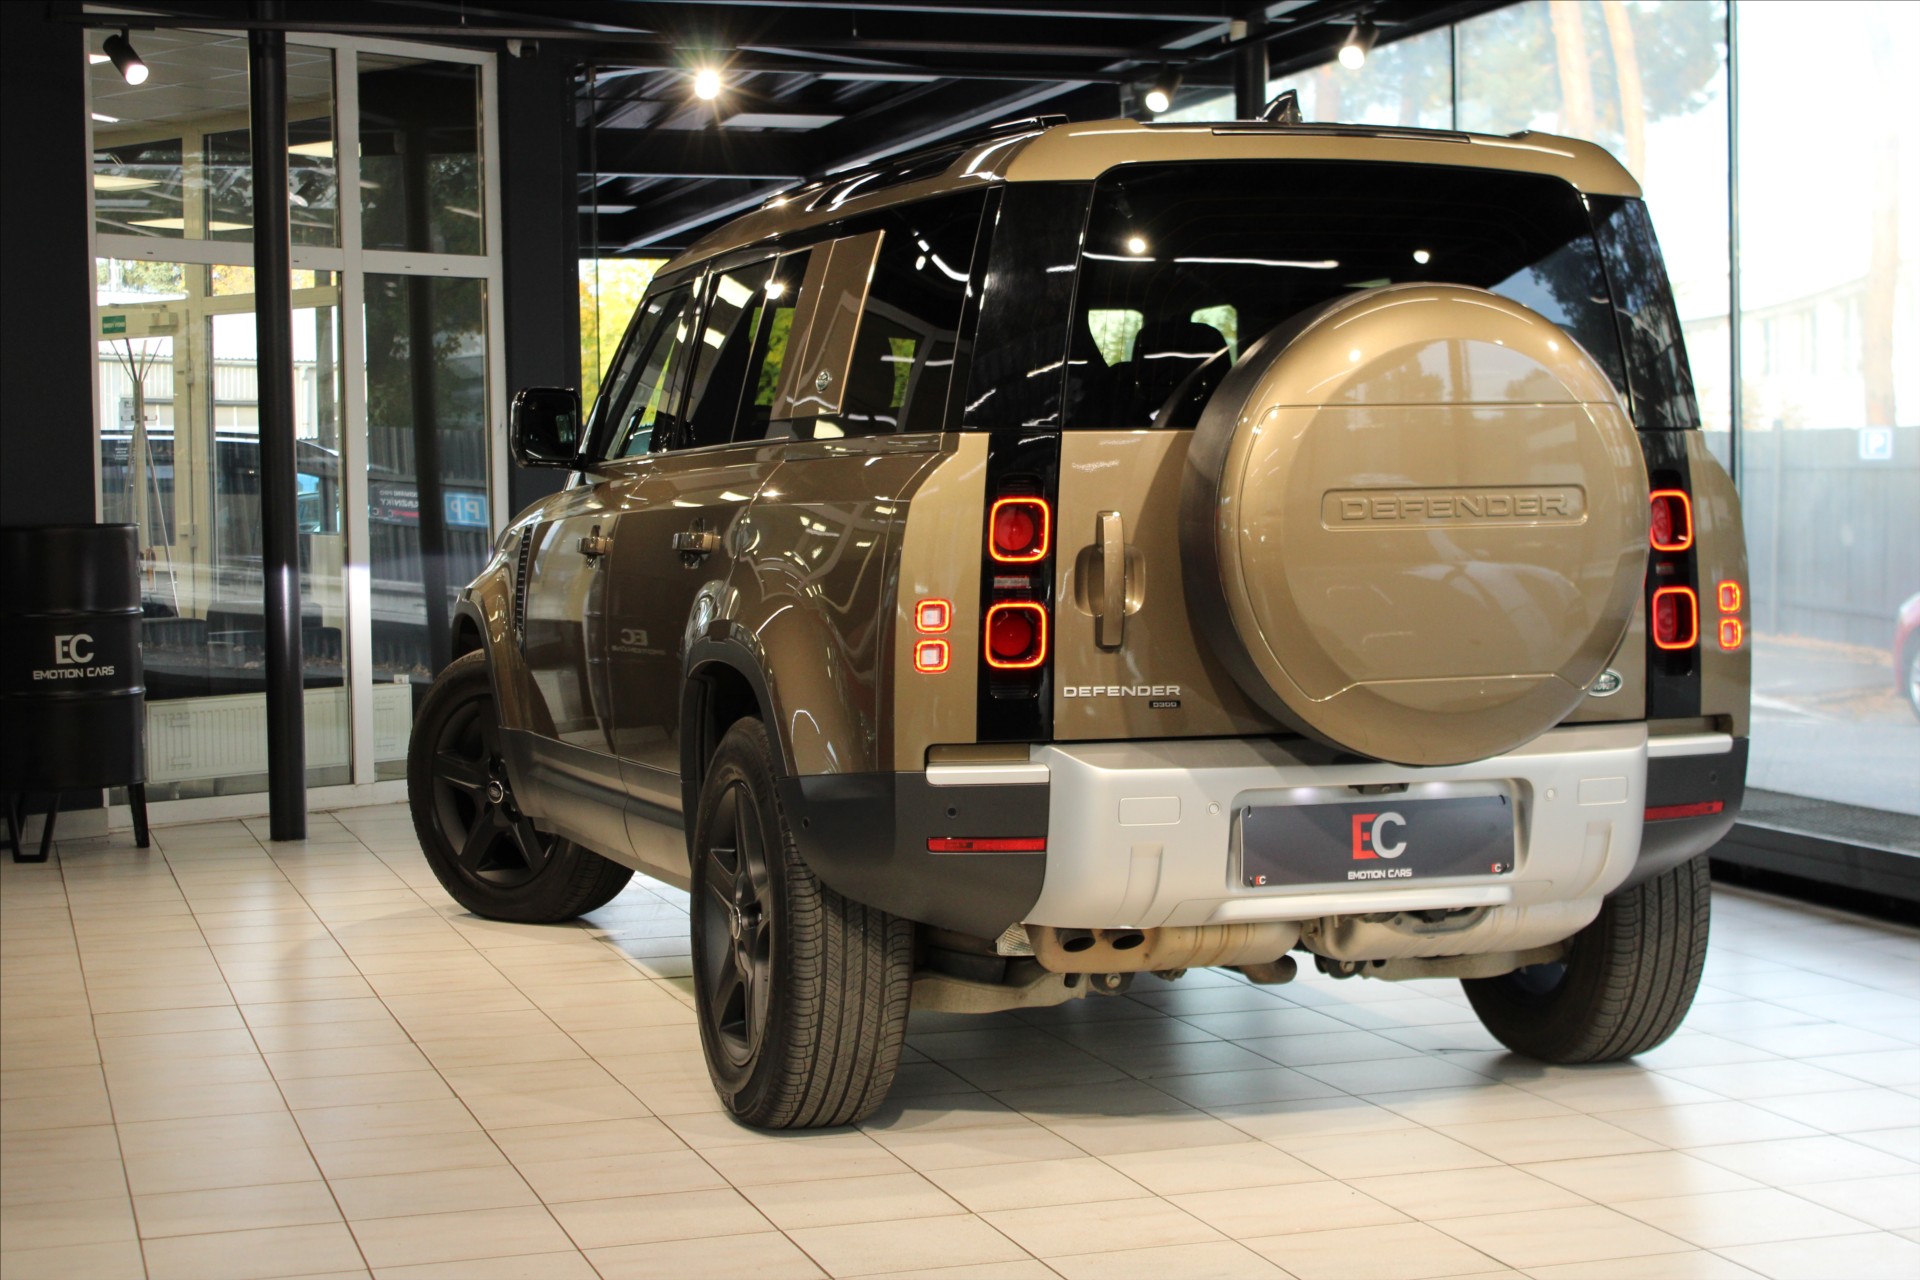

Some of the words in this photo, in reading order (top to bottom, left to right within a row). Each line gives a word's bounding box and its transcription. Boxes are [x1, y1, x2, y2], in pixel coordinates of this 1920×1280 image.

[1869, 432, 1885, 455] P
[1340, 493, 1570, 520] DEFENDER
[55, 633, 94, 664] EC
[33, 669, 83, 680] EMOTION
[86, 665, 115, 677] CARS
[1063, 685, 1181, 698] DEFENDER
[1352, 811, 1407, 860] EC
[1347, 869, 1386, 880] EMOTION
[1387, 868, 1412, 878] CARS
